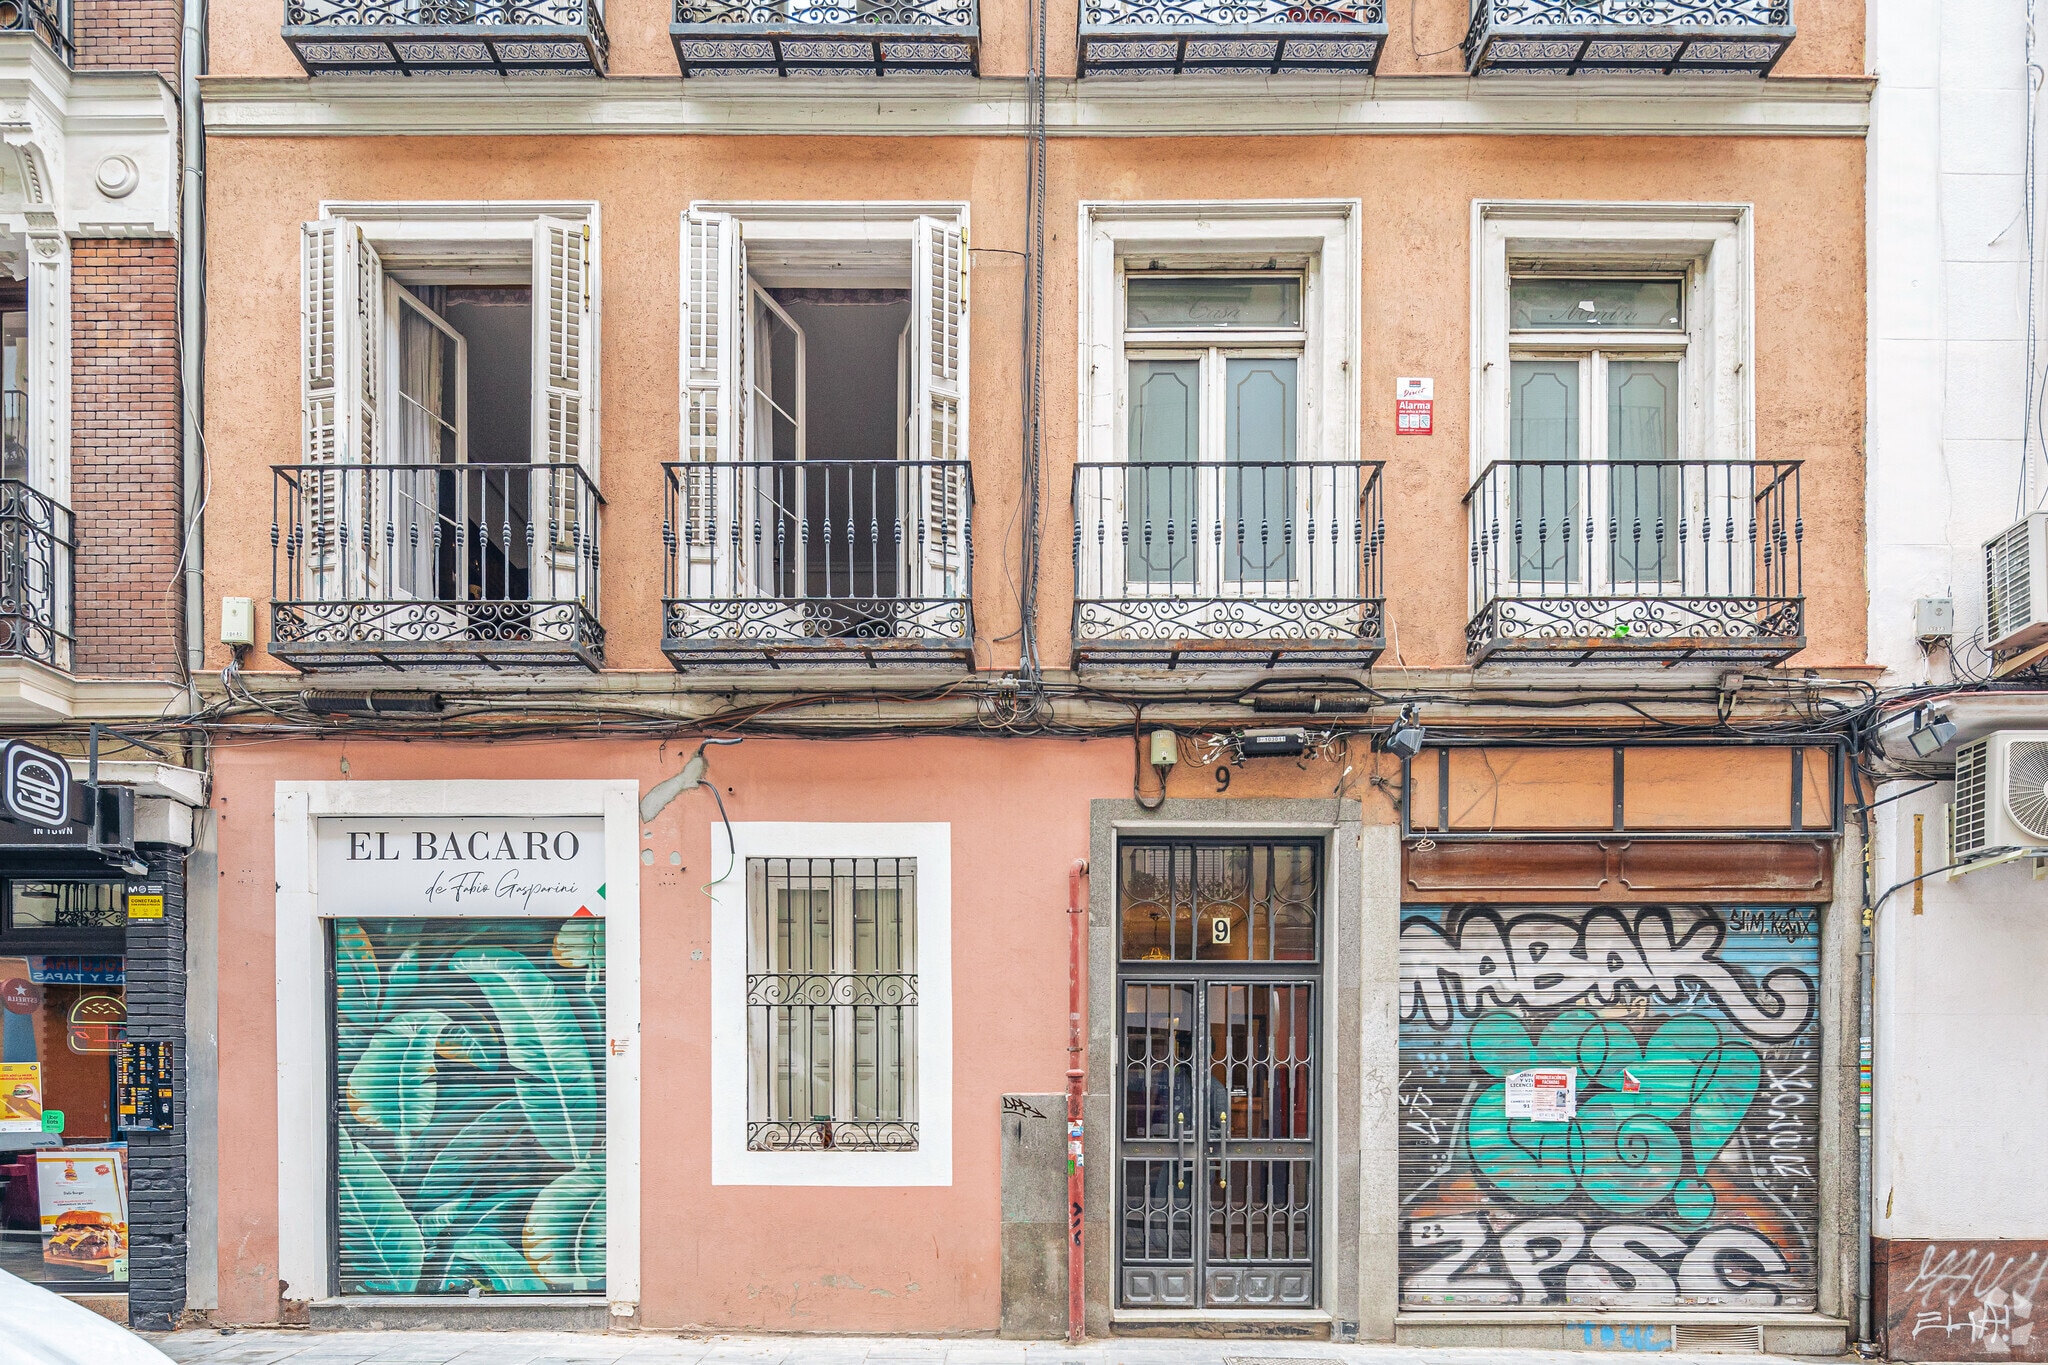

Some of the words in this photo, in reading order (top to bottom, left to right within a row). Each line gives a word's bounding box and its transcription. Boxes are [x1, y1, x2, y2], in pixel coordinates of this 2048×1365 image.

[1399, 401, 1430, 409] Alarma
[1215, 765, 1230, 792] 9
[346, 831, 400, 861] EL
[412, 830, 580, 861] BACARO
[425, 870, 446, 903] de
[448, 871, 490, 903] Fabio
[494, 868, 579, 911] Gasparini
[1215, 920, 1228, 942] 9
